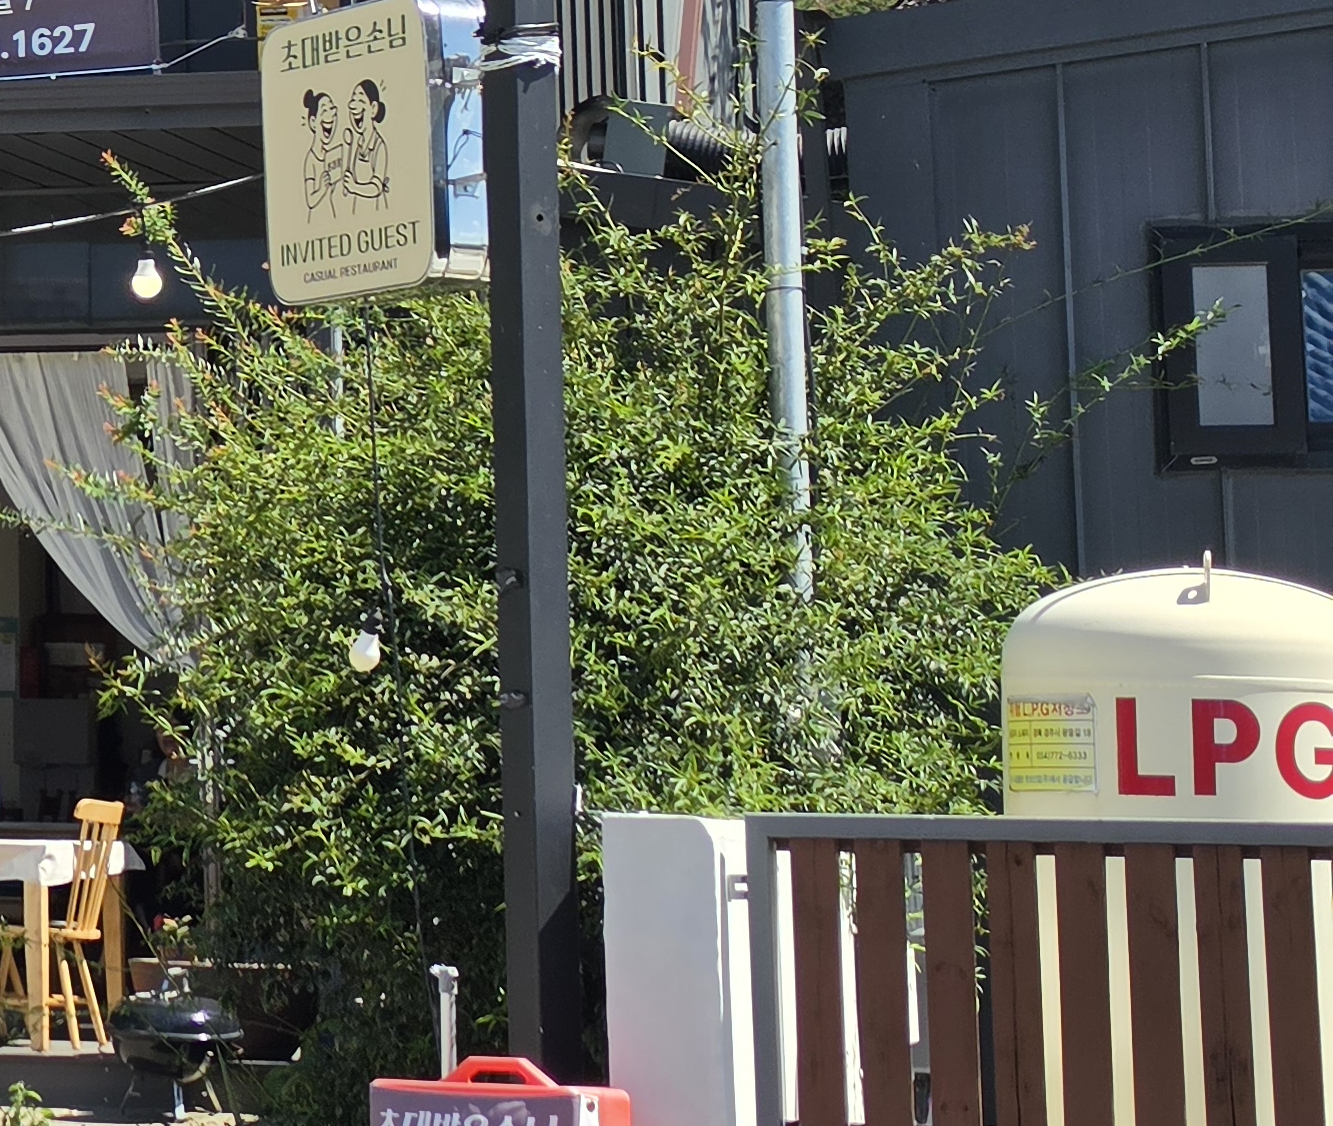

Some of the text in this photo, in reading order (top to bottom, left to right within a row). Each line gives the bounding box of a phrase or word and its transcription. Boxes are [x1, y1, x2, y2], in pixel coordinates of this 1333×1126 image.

[280, 14, 408, 73] 초대받은손님
[280, 220, 421, 267] INVITED GUEST
[303, 258, 398, 284] CASUAL RESTAURANT
[1115, 696, 1333, 800] LPG
